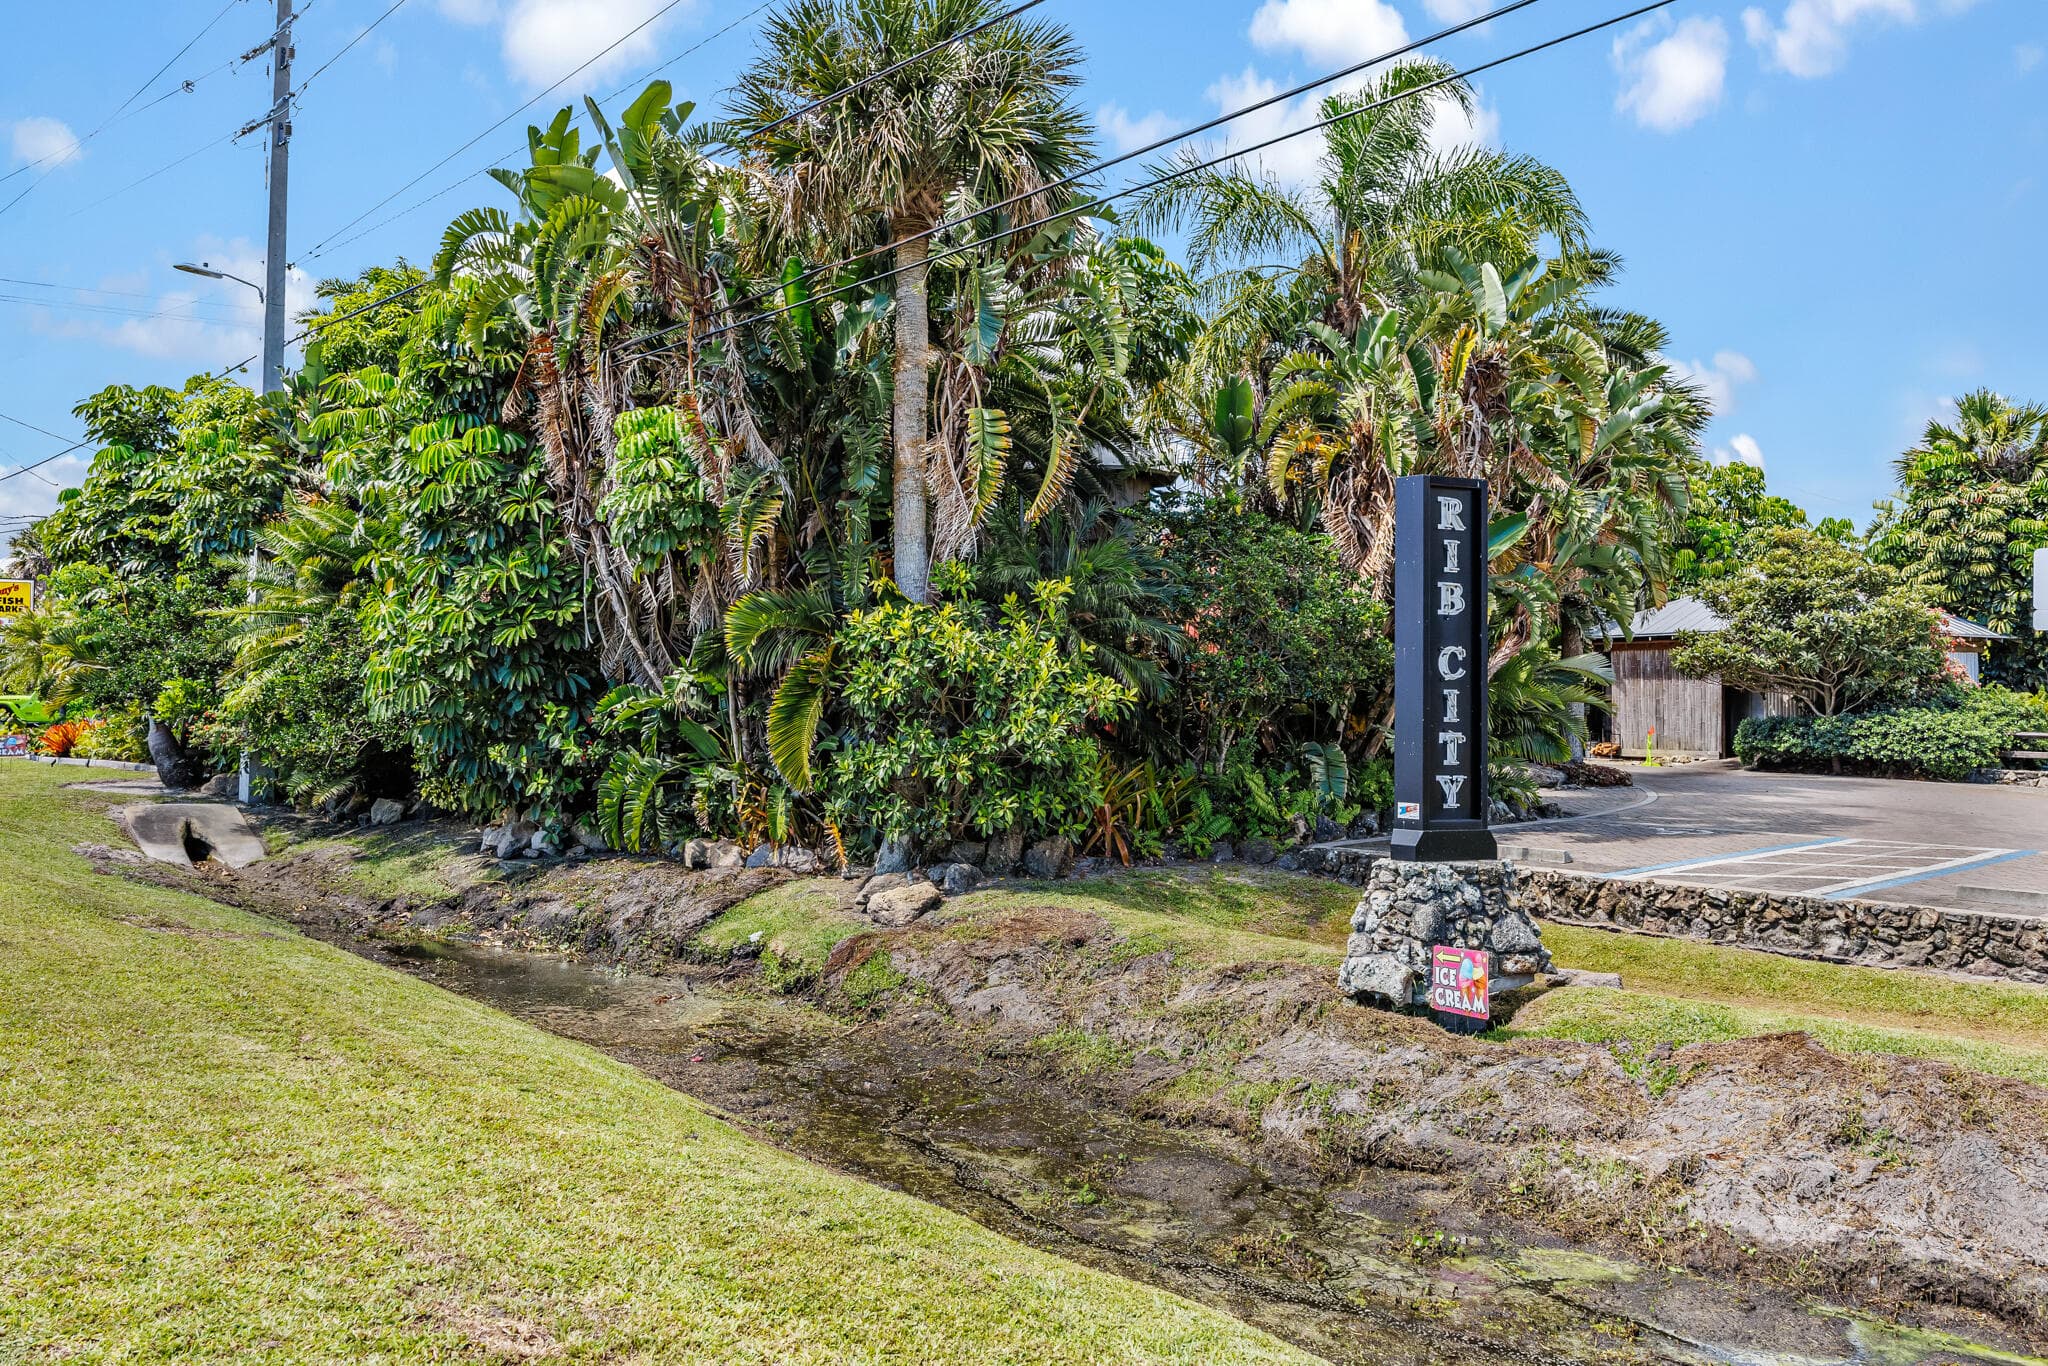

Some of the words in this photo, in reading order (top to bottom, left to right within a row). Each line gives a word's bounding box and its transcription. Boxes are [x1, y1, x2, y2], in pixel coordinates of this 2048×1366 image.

[1437, 496, 1466, 616] RIB
[0, 605, 28, 613] ARK
[1436, 645, 1467, 809] CITY
[0, 748, 24, 756] EAM
[1435, 966, 1457, 987] ICE
[1435, 987, 1487, 1014] CREAM
